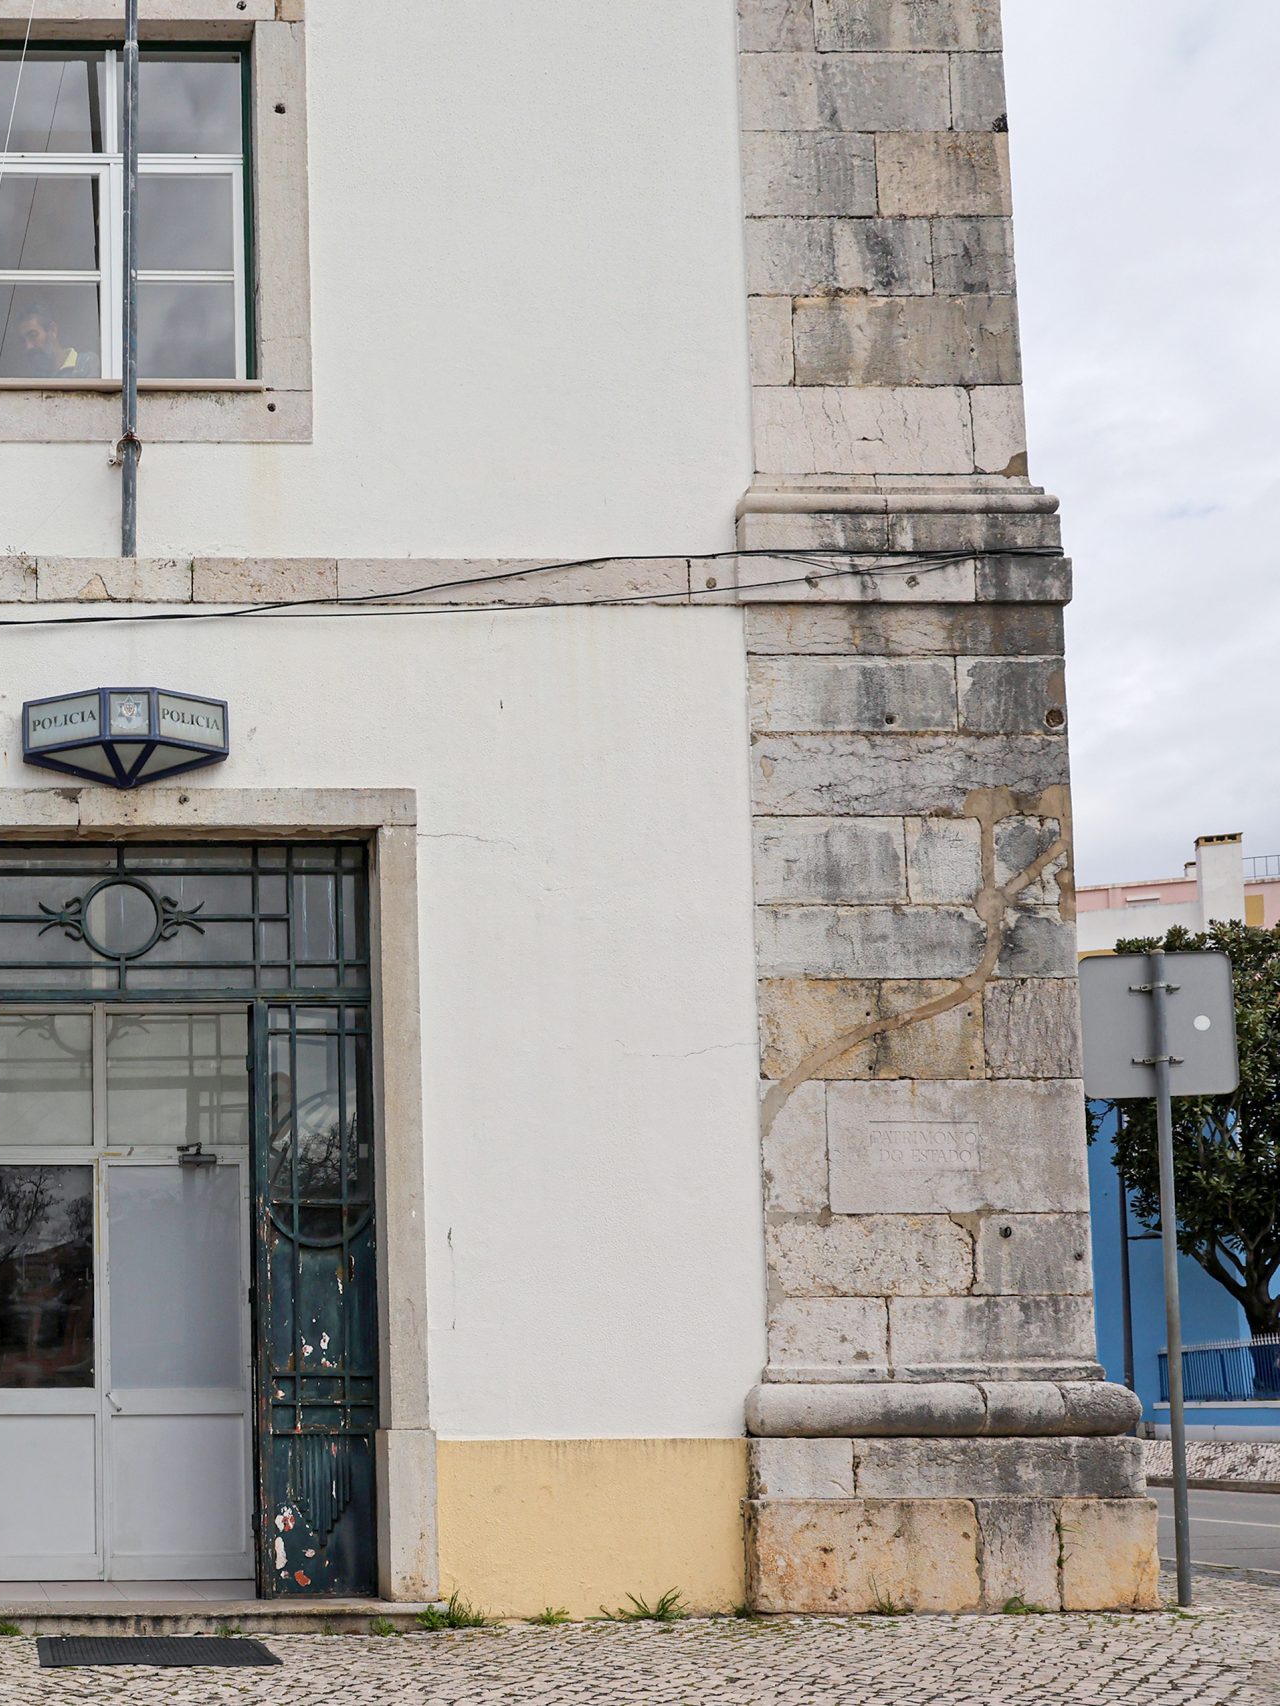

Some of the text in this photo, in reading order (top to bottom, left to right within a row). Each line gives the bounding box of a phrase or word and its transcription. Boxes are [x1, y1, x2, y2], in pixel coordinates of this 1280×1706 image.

[32, 709, 96, 731] POLICIA
[161, 708, 220, 730] POLICIA
[911, 1149, 972, 1162] ESTADO
